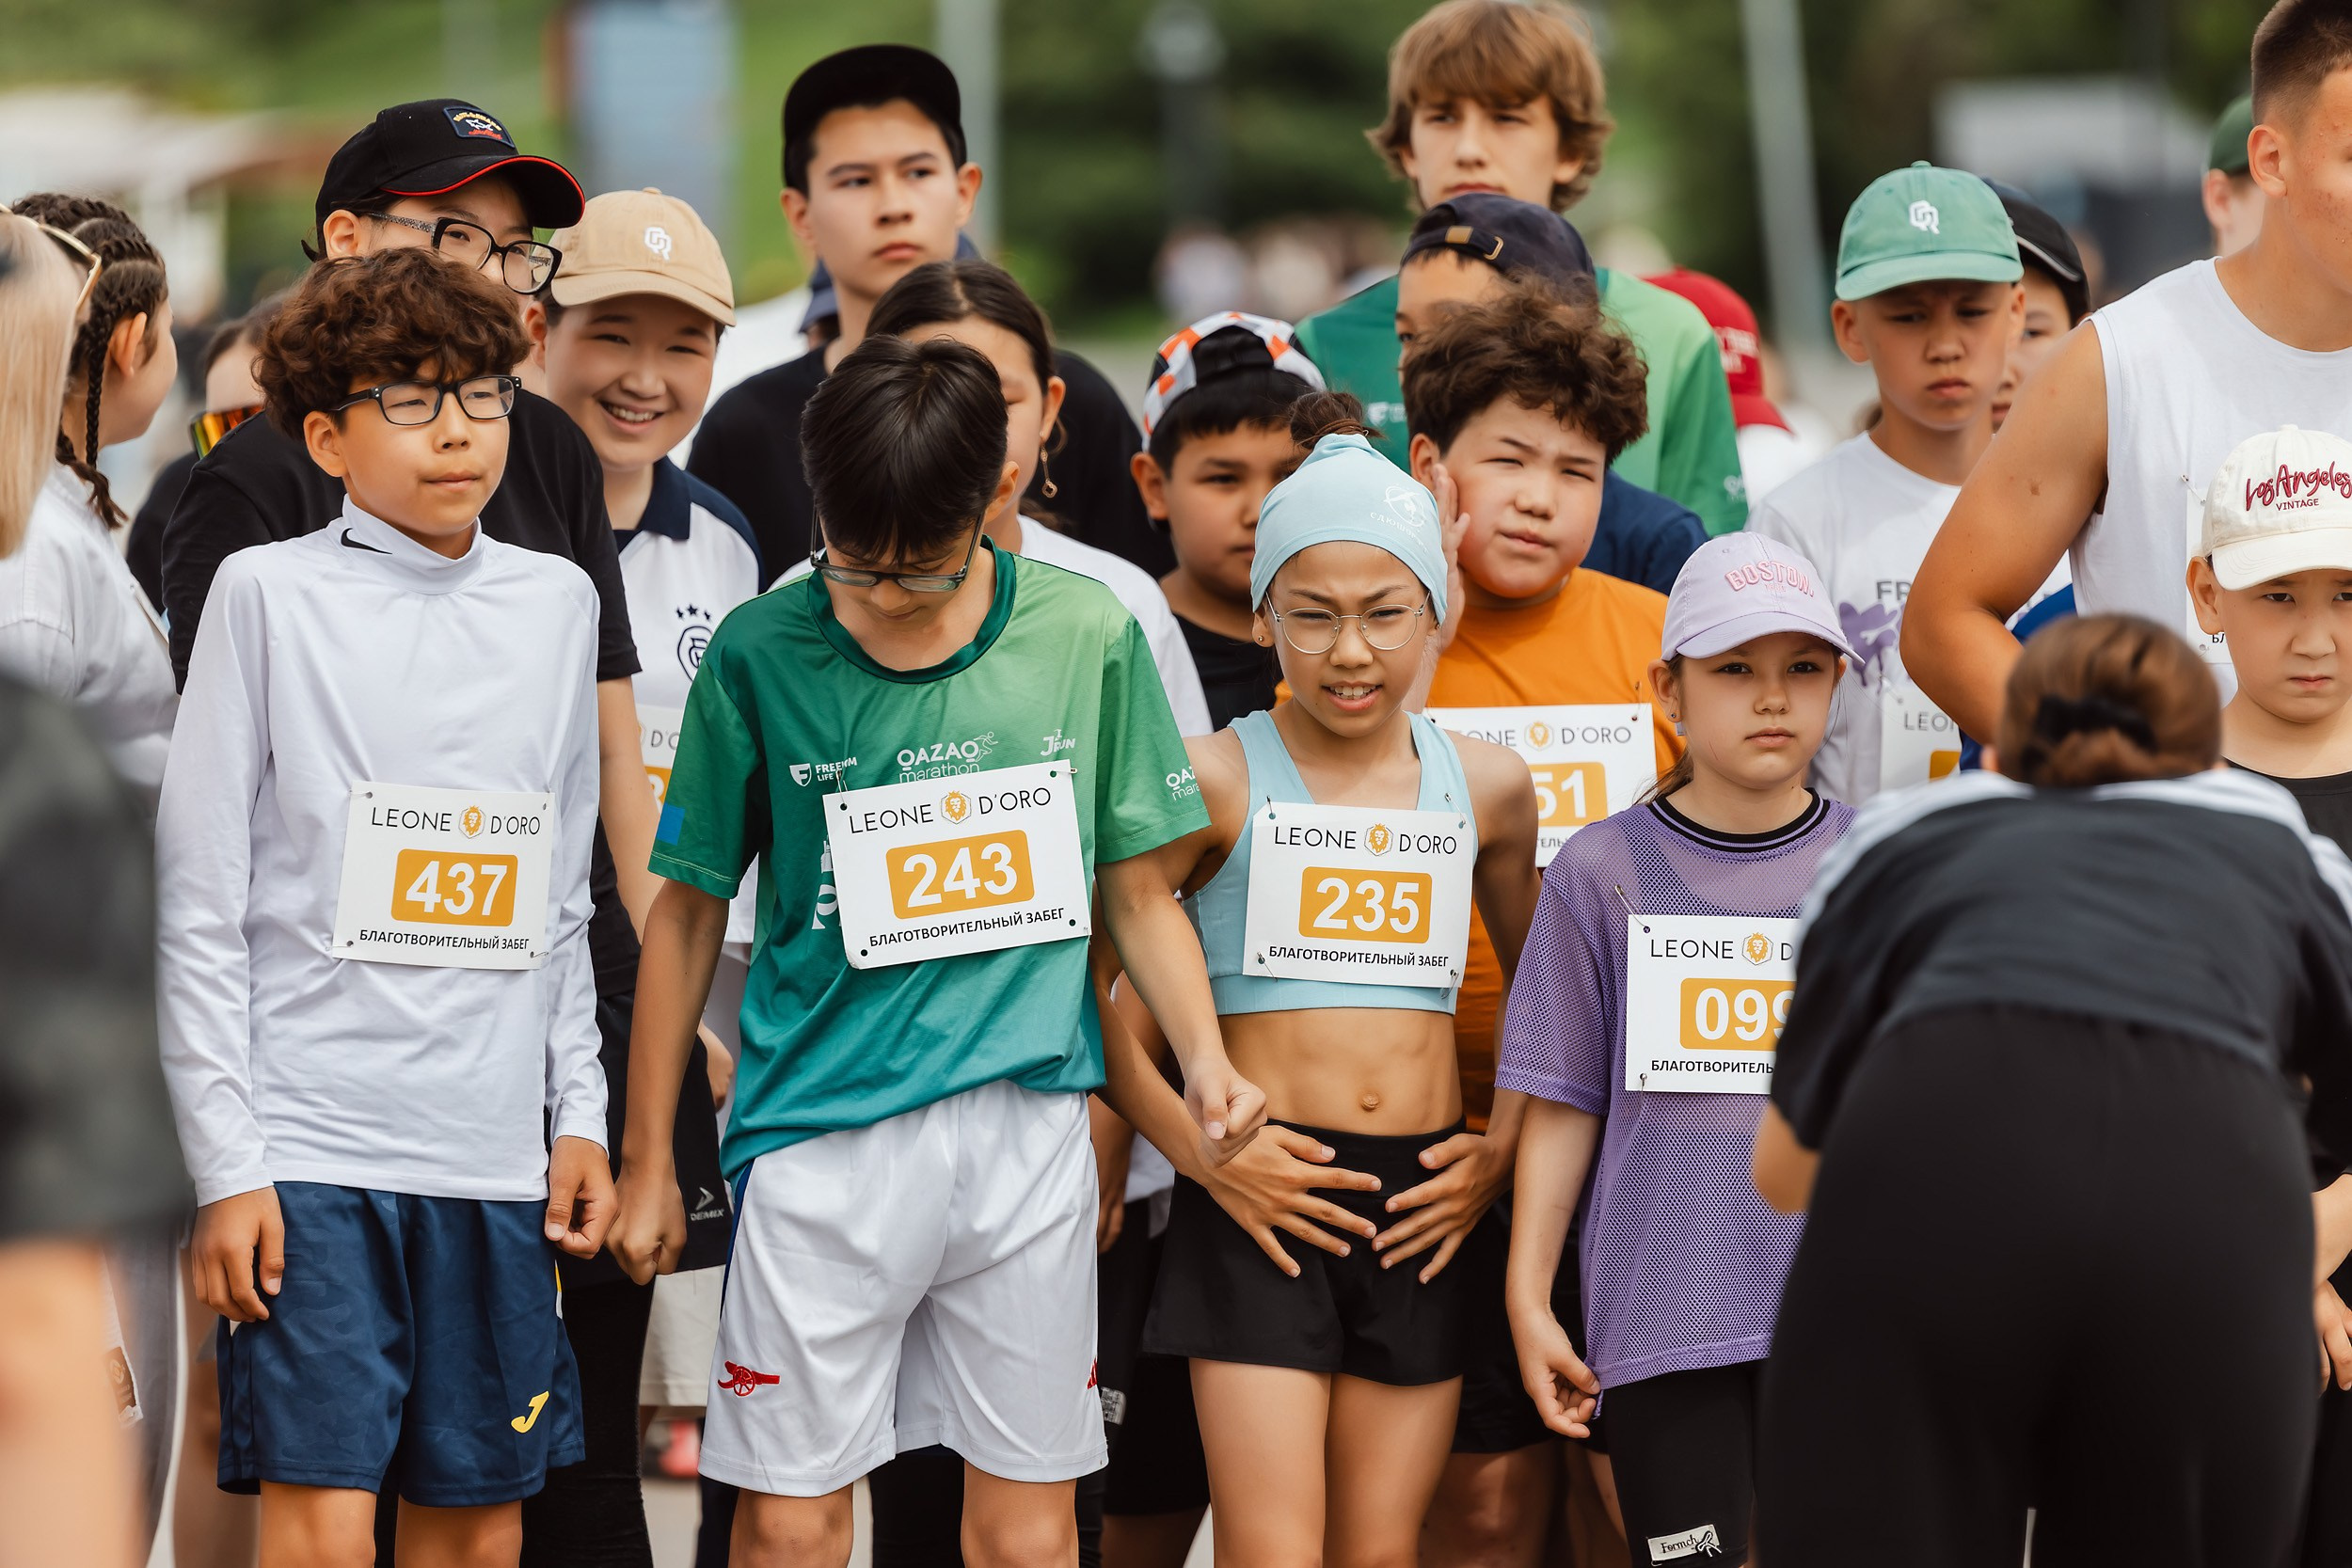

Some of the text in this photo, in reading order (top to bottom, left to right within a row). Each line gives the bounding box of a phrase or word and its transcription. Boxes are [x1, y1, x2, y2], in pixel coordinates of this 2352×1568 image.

[2276, 460, 2352, 499] Angeles
[2276, 499, 2319, 511] VINTAGE
[1904, 712, 1954, 732] LEO
[651, 730, 680, 751] D'O
[1562, 726, 1631, 745] D'ORO
[815, 756, 858, 773] FREEM
[899, 763, 979, 784] marathon
[817, 773, 834, 782] LIFE
[1531, 769, 1587, 820] 51
[372, 807, 540, 835] LEONE D'ORO
[850, 787, 1051, 834] LEONE D'ORO
[1274, 826, 1457, 855] LEONE D'ORO
[903, 842, 1018, 908] 243
[405, 860, 507, 916] 437
[1312, 877, 1420, 934] 235
[869, 908, 1065, 947] БЛАГОТВОРИТЕЛЬНЫЙ ЗАБЕГ
[359, 929, 530, 950] БЛАГОТВОРИТЕЛЬНЫЙ ЗАБЕГ
[1650, 939, 1734, 959] LEONE
[1269, 945, 1449, 967] БЛАГОТВОРИТЕЛЬНЫЙ ЗАБЕГ
[1651, 1060, 1773, 1074] БЛАГОТВОРИТЕЛЬ
